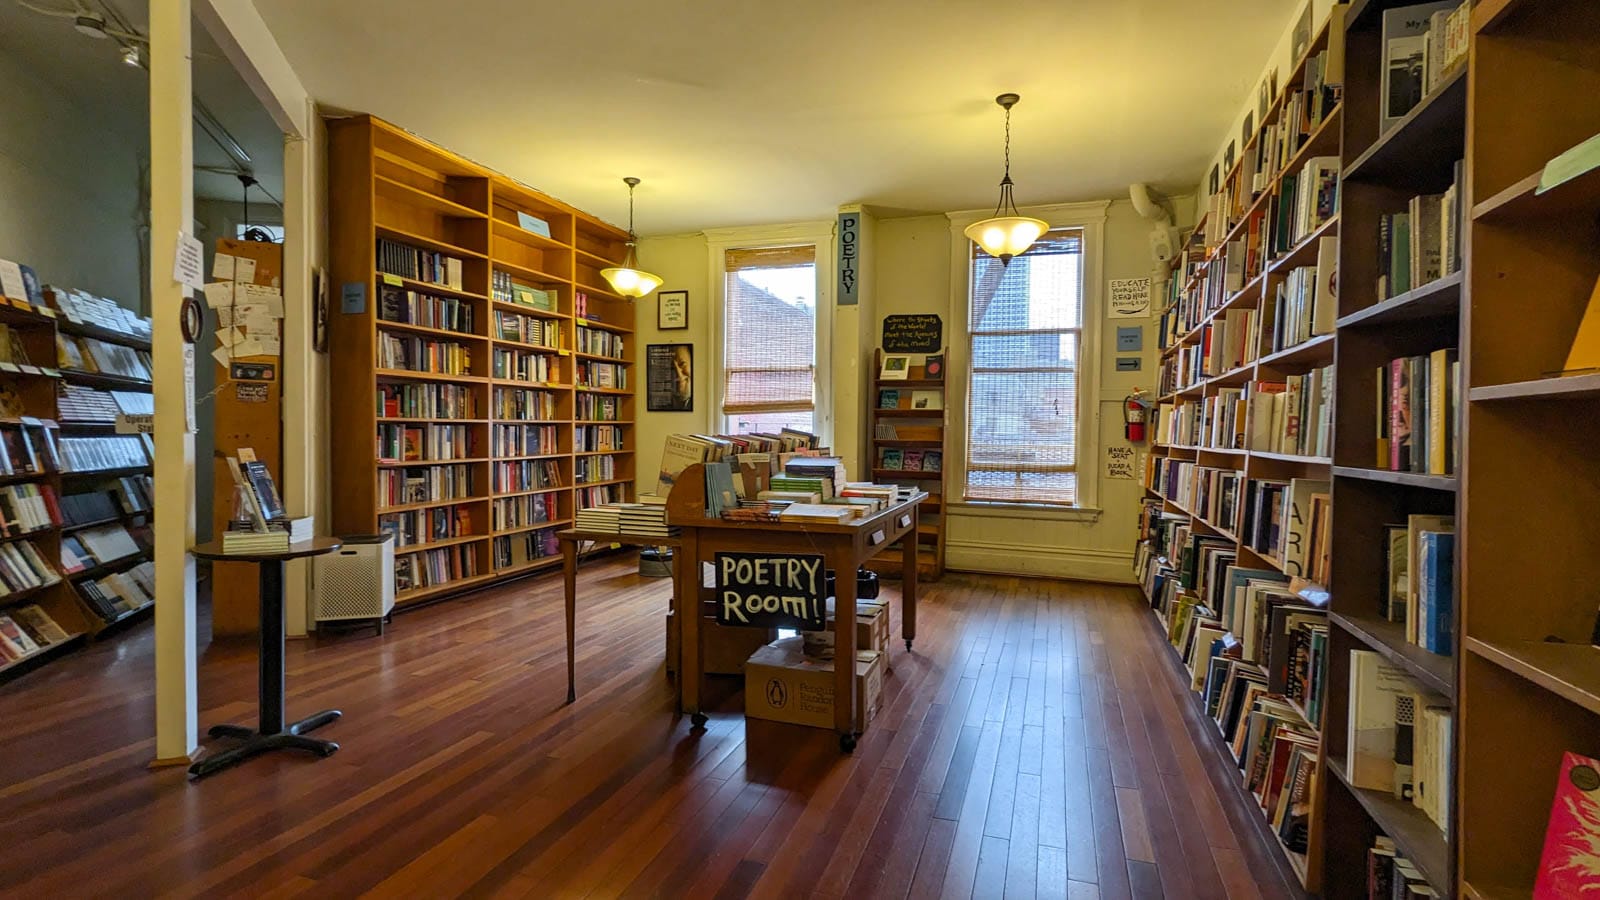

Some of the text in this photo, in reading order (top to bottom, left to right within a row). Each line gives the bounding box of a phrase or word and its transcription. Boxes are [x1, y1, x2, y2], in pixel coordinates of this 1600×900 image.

[842, 218, 856, 294] POETRY
[1112, 279, 1149, 287] EDUCATE
[1112, 286, 1147, 294] YOURSELF
[721, 556, 821, 595] POETRY
